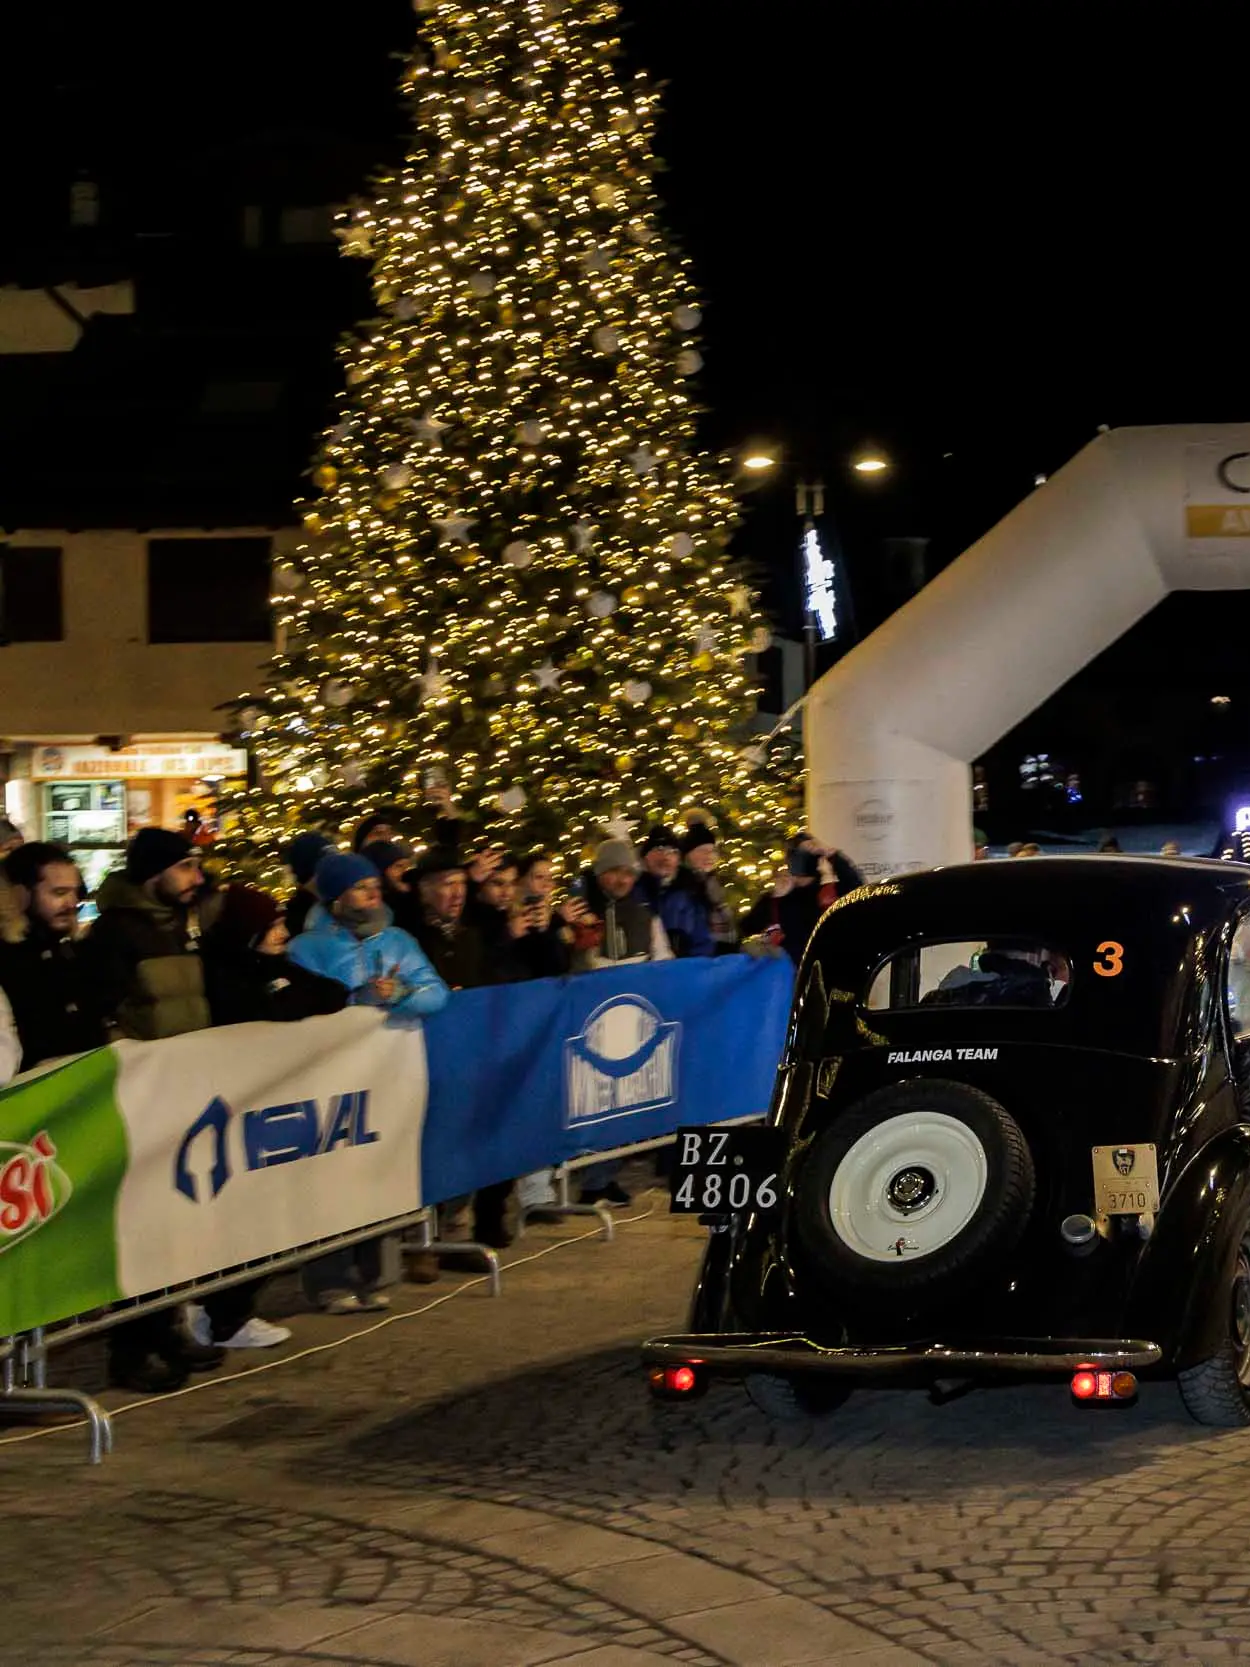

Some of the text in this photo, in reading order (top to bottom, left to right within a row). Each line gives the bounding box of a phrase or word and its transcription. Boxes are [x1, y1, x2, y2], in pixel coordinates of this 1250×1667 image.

[1093, 941, 1124, 976] 3
[887, 1048, 998, 1064] FALANGA TEAM
[675, 1173, 777, 1208] 4806
[1108, 1192, 1146, 1209] 3710
